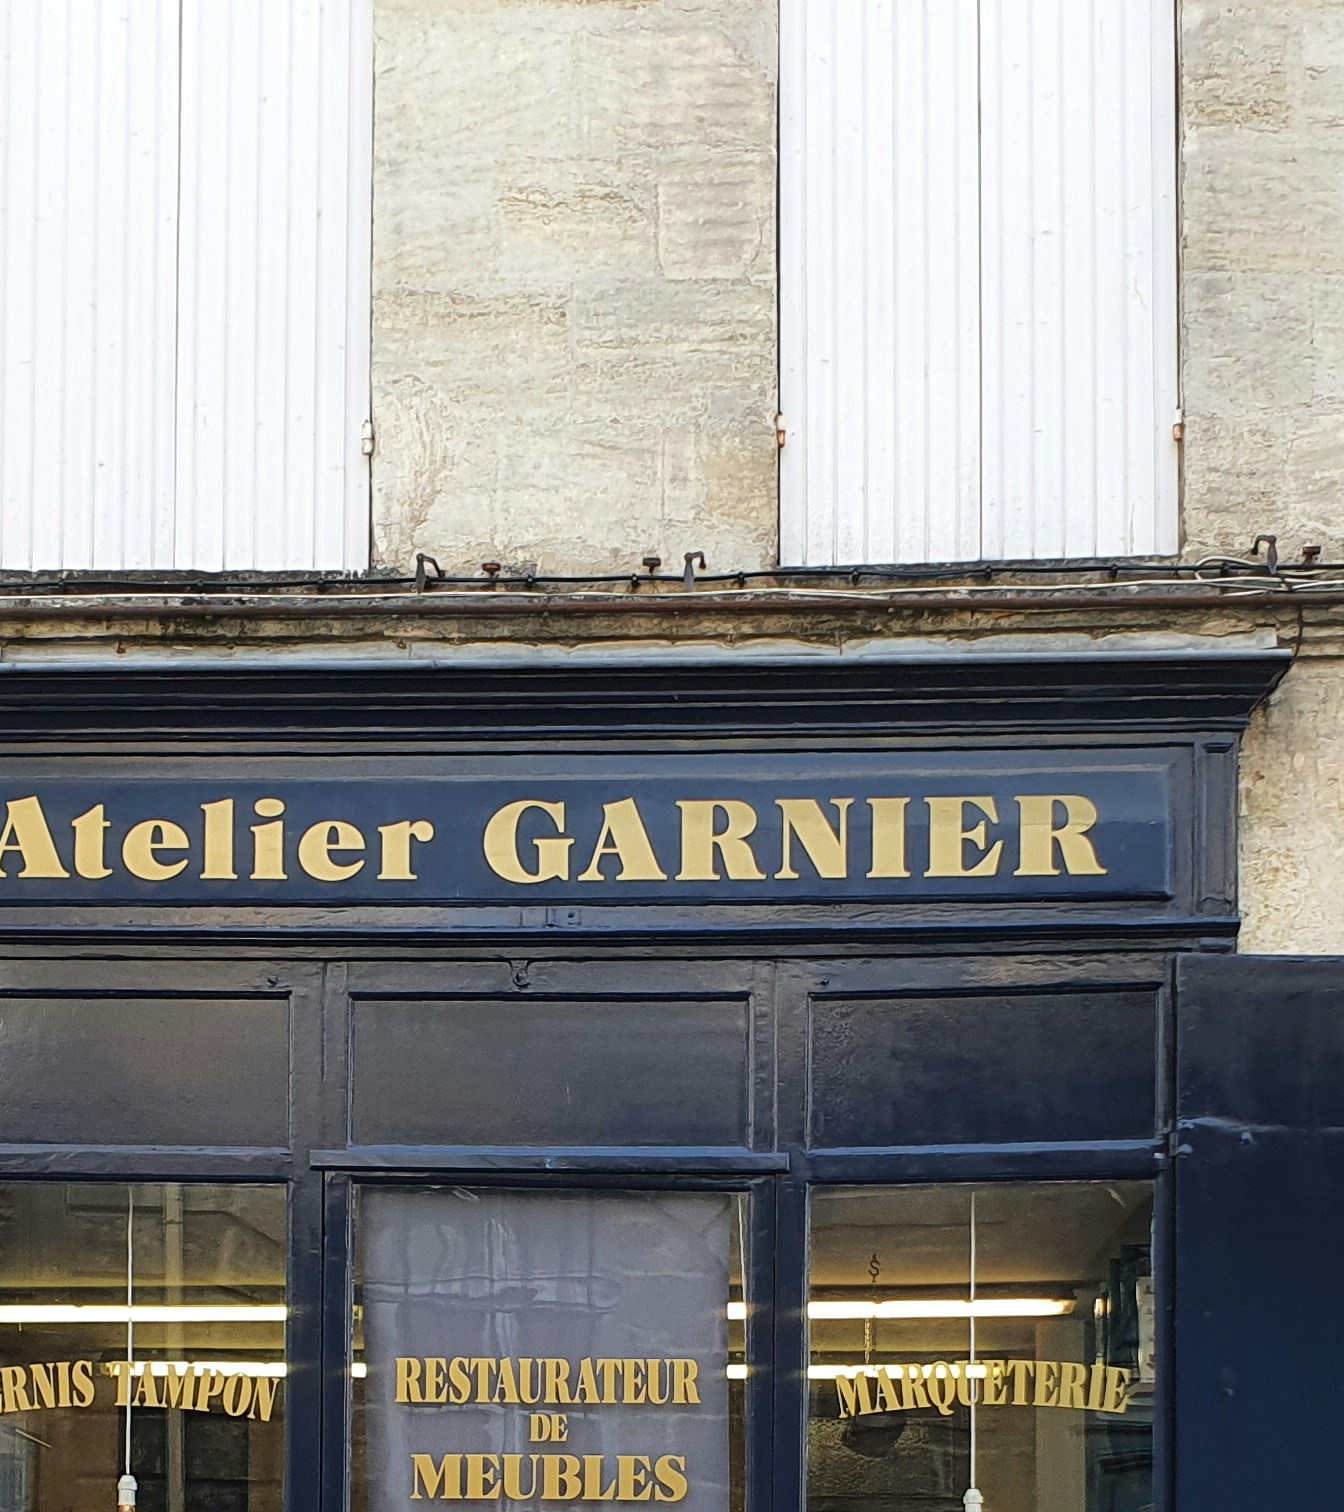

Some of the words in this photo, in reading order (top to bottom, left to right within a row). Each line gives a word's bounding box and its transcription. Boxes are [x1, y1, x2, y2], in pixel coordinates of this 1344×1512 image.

[482, 793, 1109, 883] GARNIER
[109, 1360, 282, 1422] TAMPON
[394, 1356, 701, 1404] RESTAURATEUR
[835, 1359, 1132, 1419] MARQUETERIE
[529, 1414, 568, 1442] DE
[410, 1453, 688, 1502] MEUBLES
